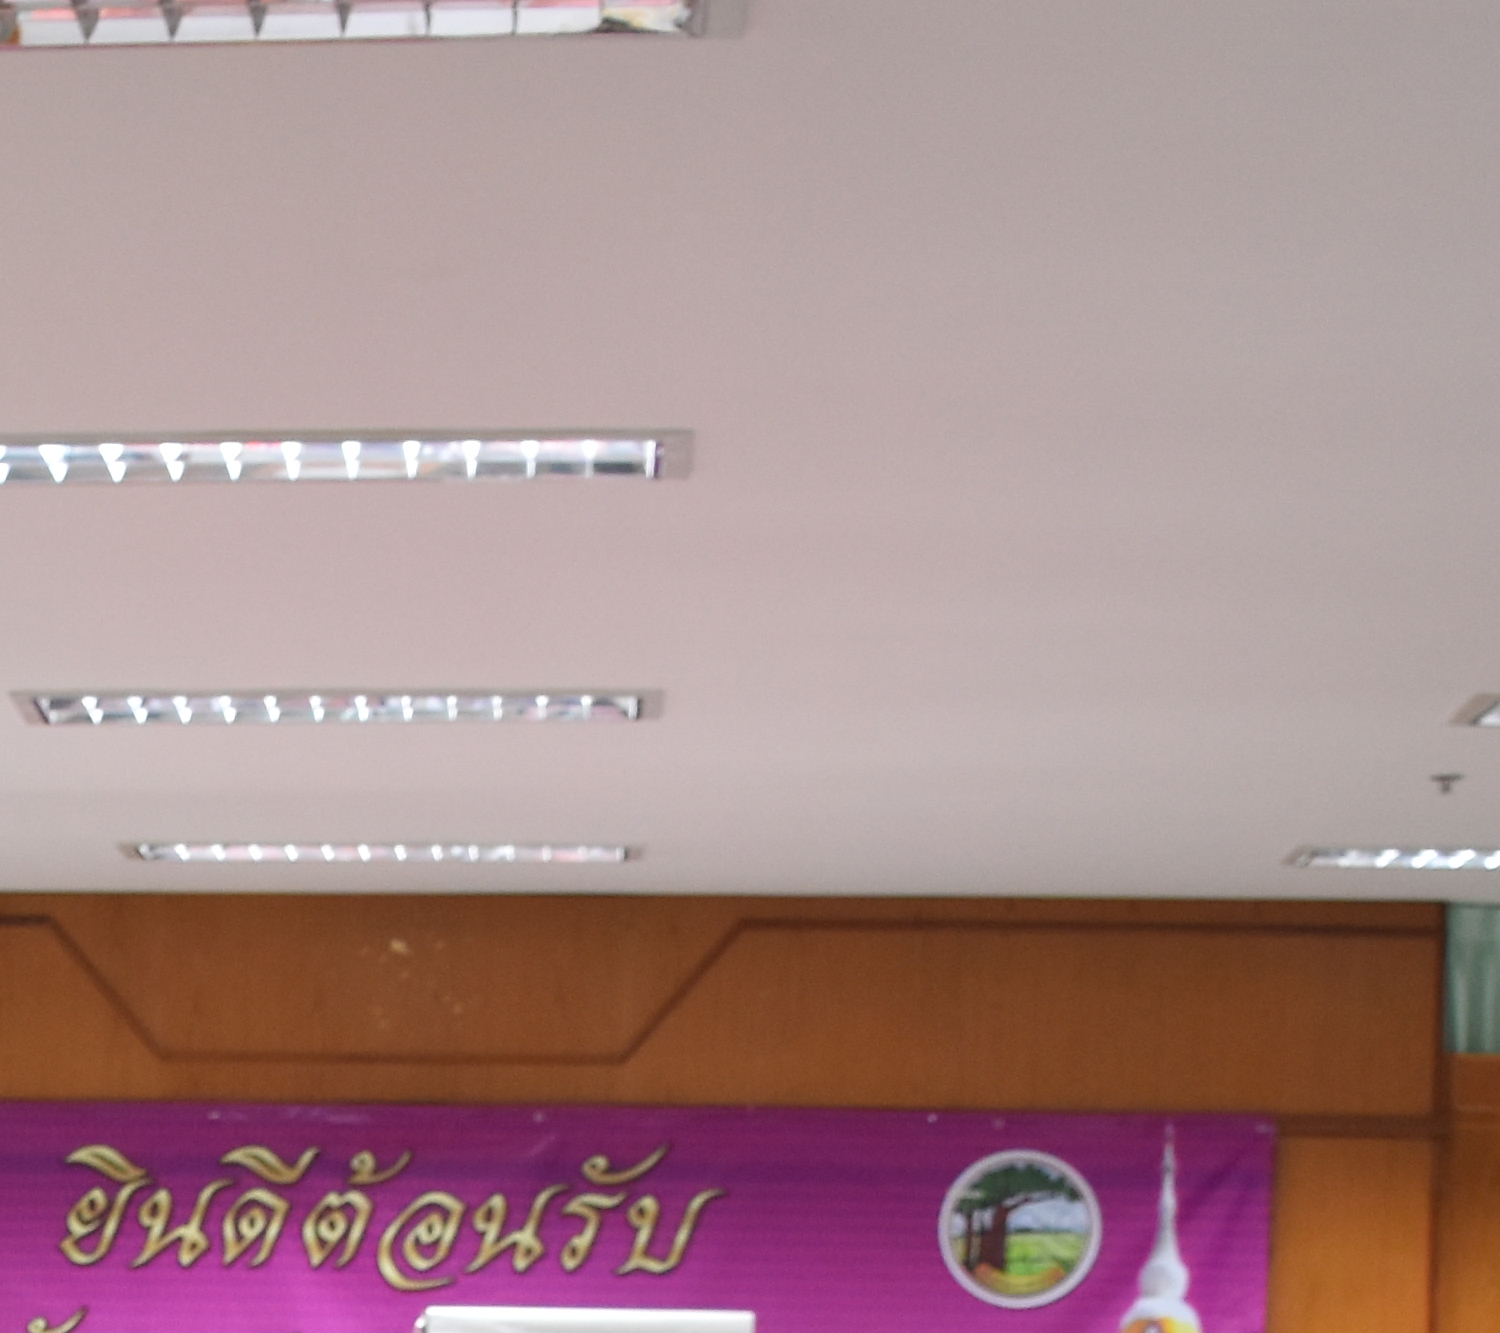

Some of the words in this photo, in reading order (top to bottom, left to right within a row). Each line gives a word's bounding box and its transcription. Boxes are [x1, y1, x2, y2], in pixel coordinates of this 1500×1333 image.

[58, 1144, 724, 1292] ยินดีต้อนรับ
